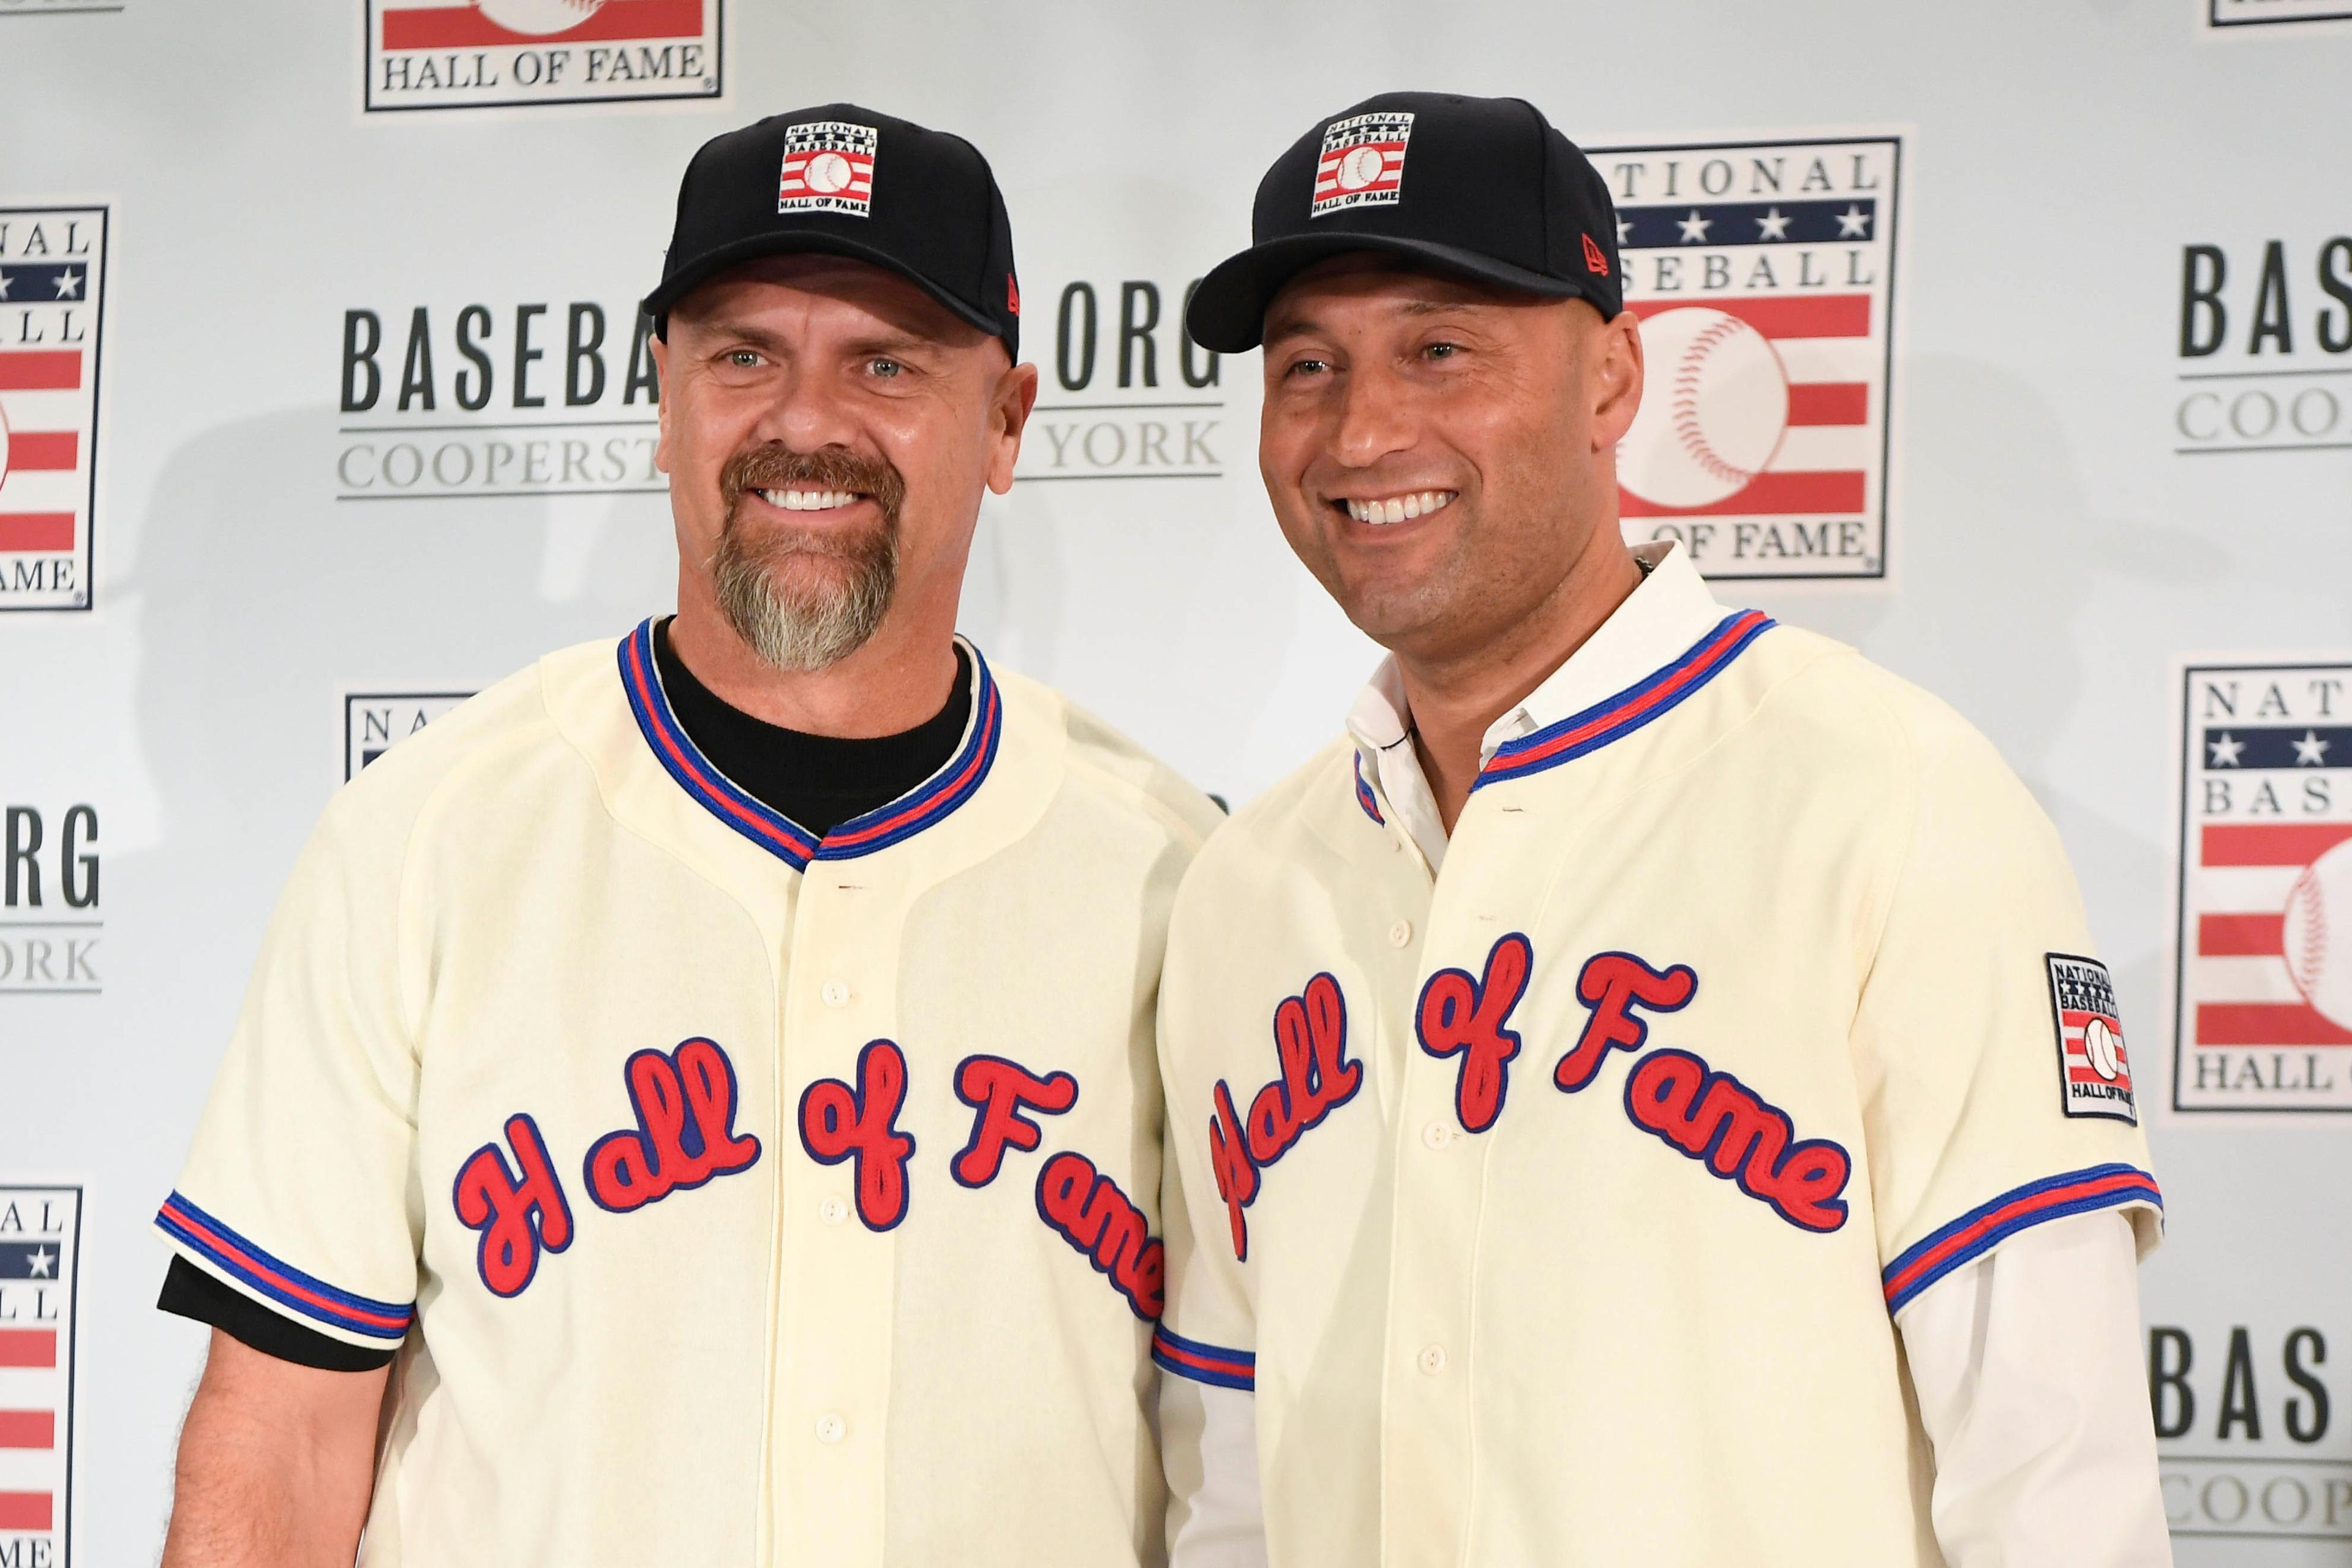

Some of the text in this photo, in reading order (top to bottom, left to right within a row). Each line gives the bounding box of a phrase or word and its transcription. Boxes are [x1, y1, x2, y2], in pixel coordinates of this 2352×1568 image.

[382, 44, 704, 91] HALL OF FAME
[791, 123, 874, 138] NATIONAL
[1329, 113, 1409, 132] NATIONAL
[788, 141, 872, 155] BASEBALL
[1325, 132, 1405, 153] BASEBALL
[780, 197, 869, 213] HALL OF FAME
[1313, 190, 1398, 213] HALL OF FAME
[1044, 420, 1221, 468] YORK
[1732, 521, 1864, 558] FAME
[2053, 963, 2112, 987] NATION
[1416, 932, 1533, 1134] of
[1553, 951, 1850, 1234] Fame
[2194, 1054, 2334, 1090] HALL
[2071, 1083, 2106, 1098] HALL
[453, 1037, 1164, 1323] Hall of Fame
